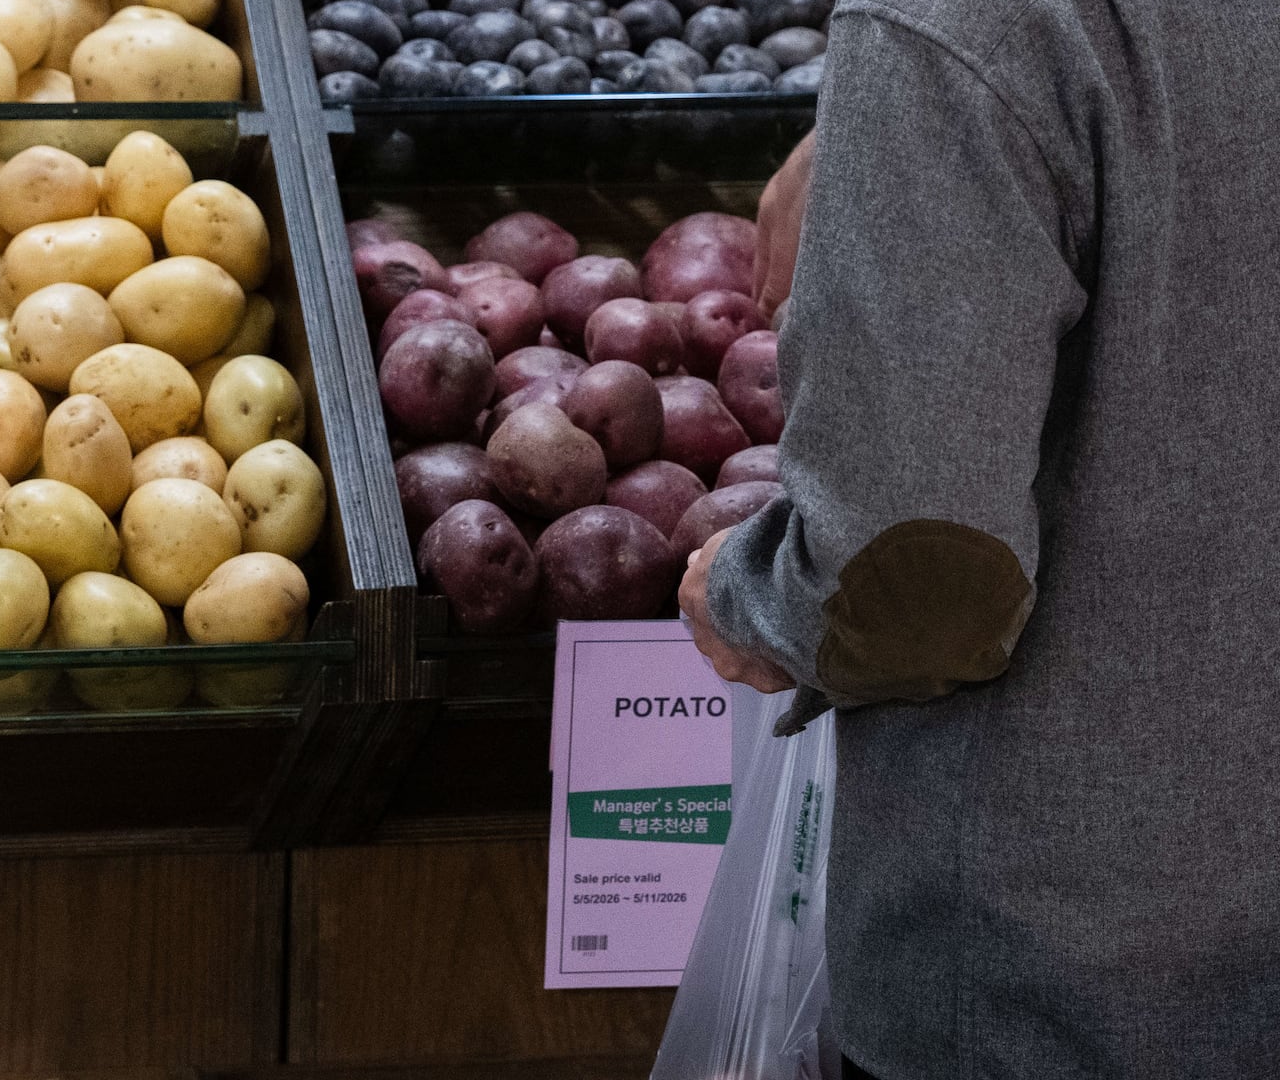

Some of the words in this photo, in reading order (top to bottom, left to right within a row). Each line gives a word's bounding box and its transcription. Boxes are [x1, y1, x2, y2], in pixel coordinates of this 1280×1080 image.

[614, 696, 727, 718] POTATO
[677, 797, 732, 814] Special
[618, 817, 708, 835] 특별추천상품
[574, 873, 599, 885] Sale
[602, 874, 632, 886] price
[634, 873, 661, 883] valid
[573, 893, 621, 905] 5/5/2026
[633, 892, 688, 904] 5/11/2026
